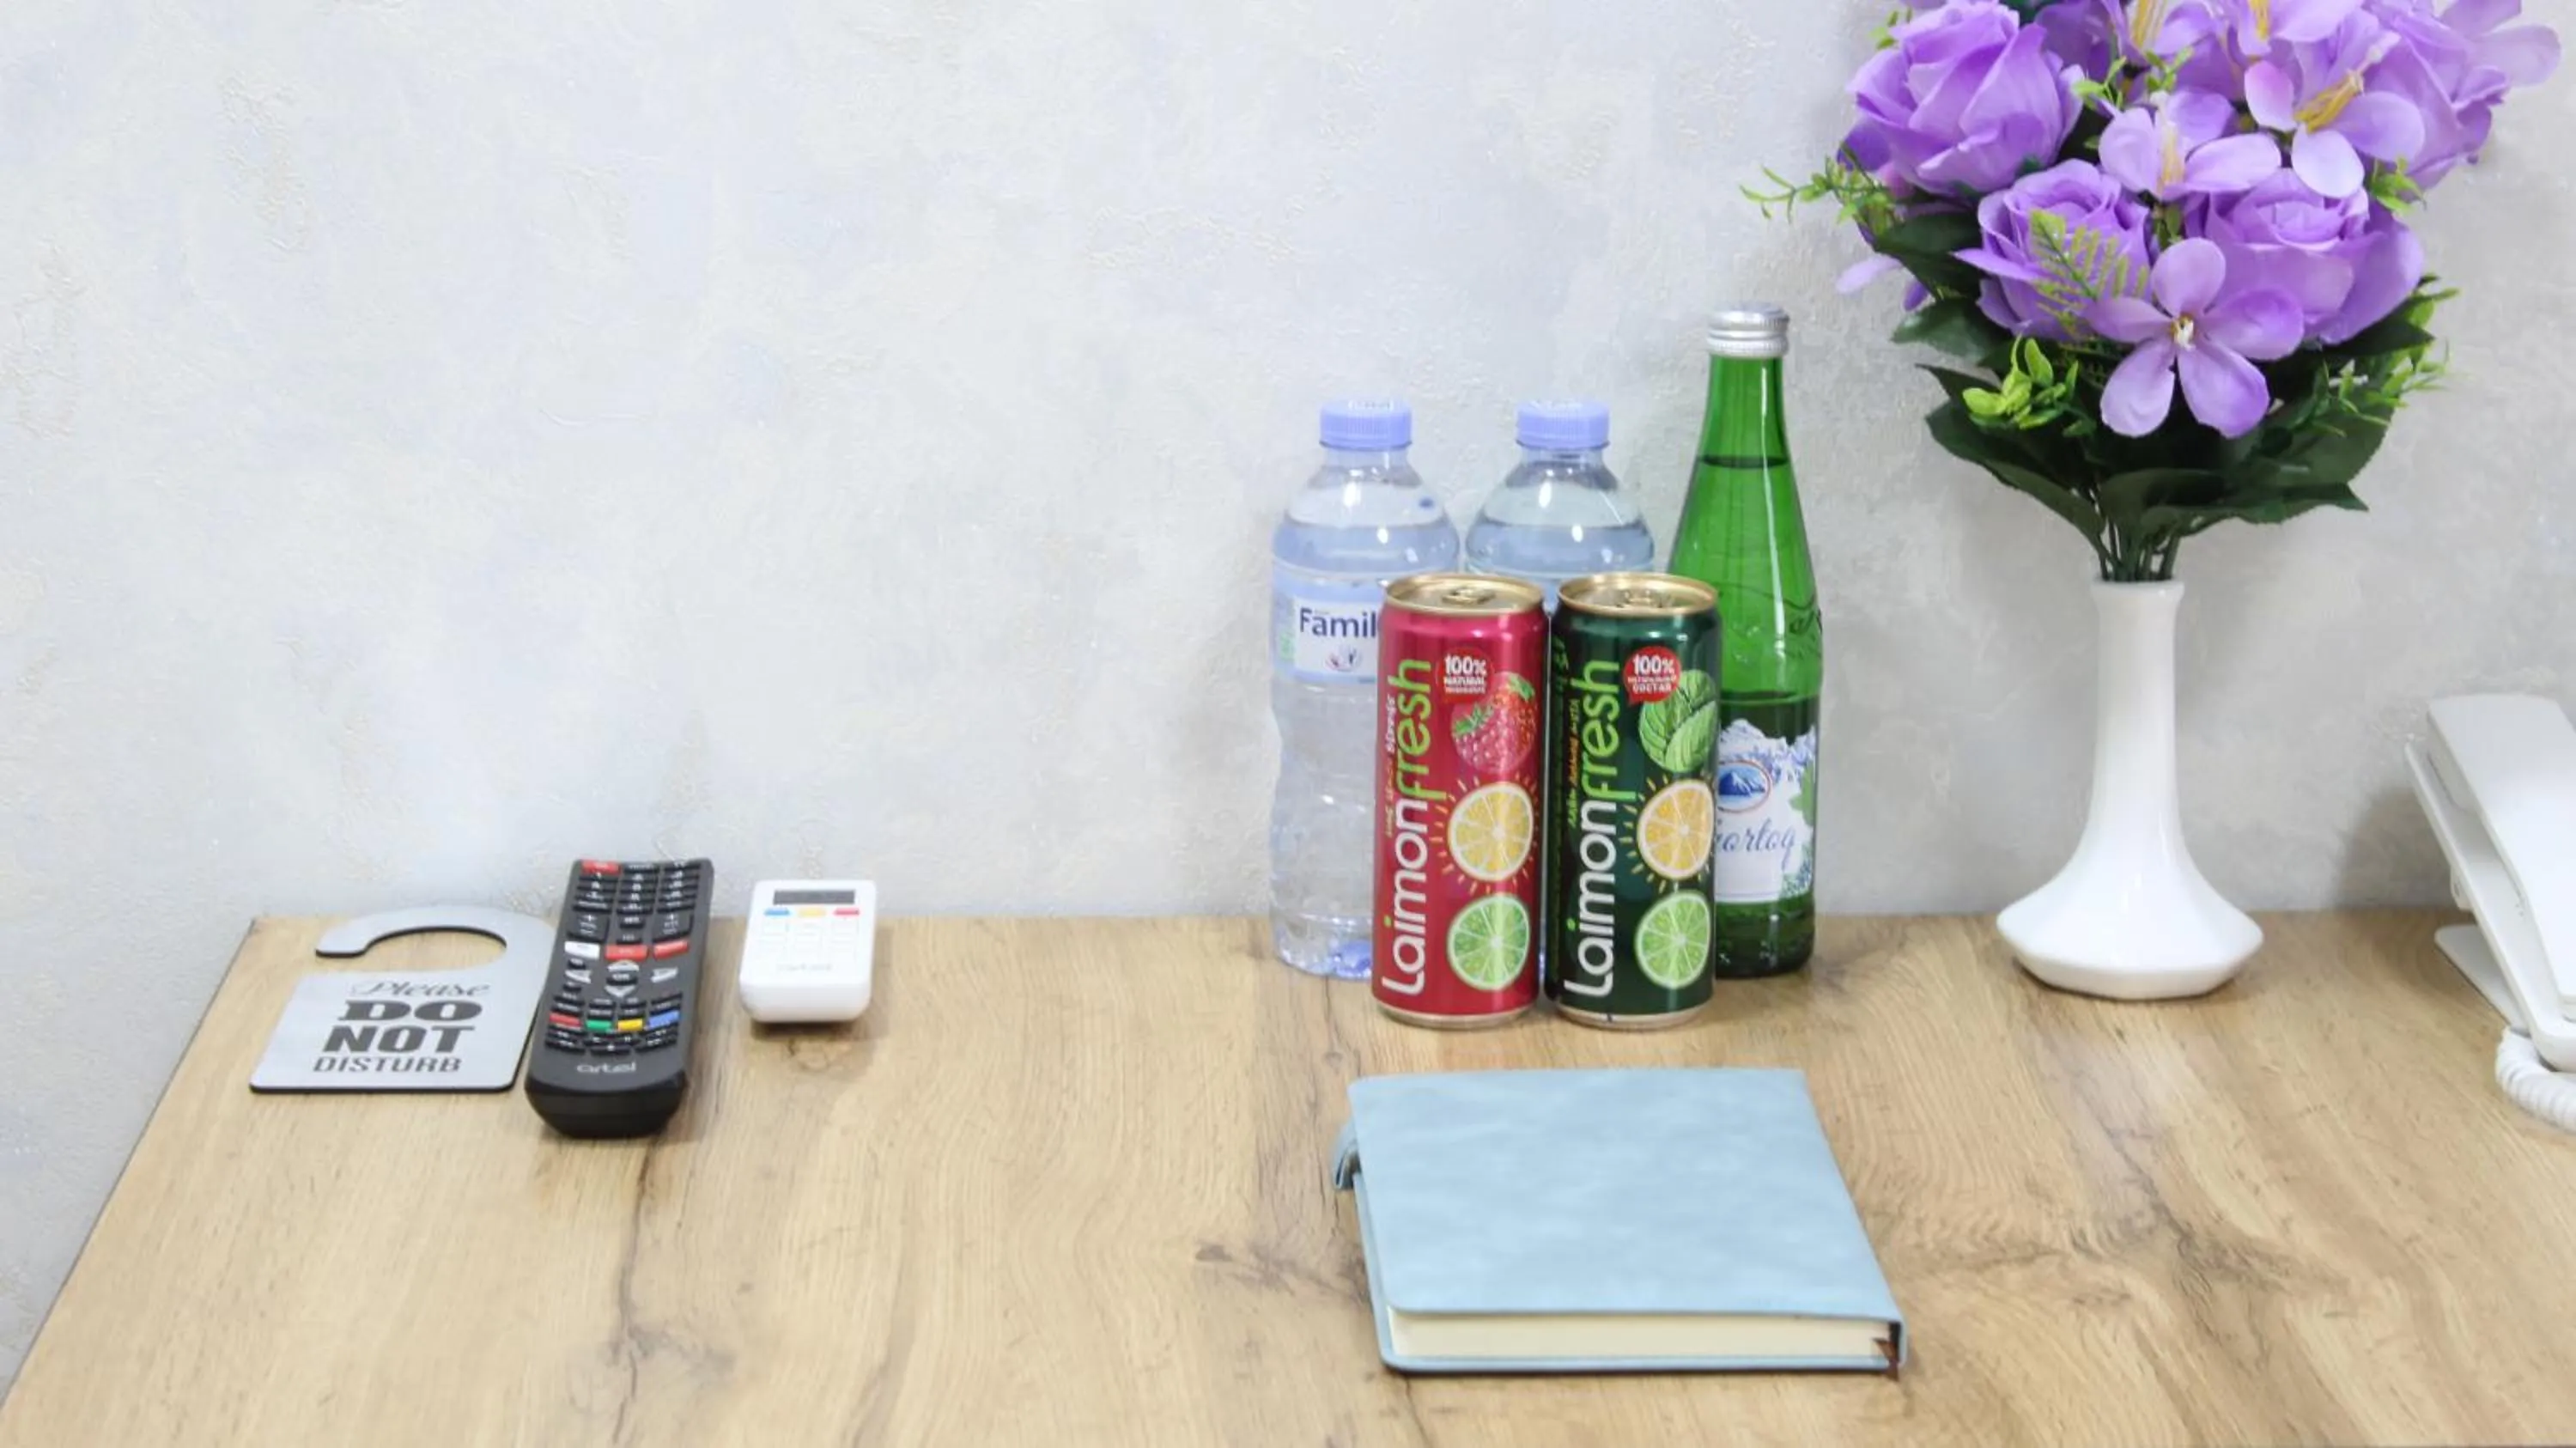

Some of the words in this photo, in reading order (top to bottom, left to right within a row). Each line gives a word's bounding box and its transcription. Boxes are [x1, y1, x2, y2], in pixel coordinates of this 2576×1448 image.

[1299, 606, 1376, 638] Famil
[1444, 654, 1487, 676] 100%
[1633, 654, 1675, 675] 100%
[352, 981, 490, 997] Please
[337, 1000, 483, 1021] DO
[322, 1025, 476, 1054] NOT
[313, 1056, 462, 1073] DISTURB
[576, 1062, 637, 1074] artel
